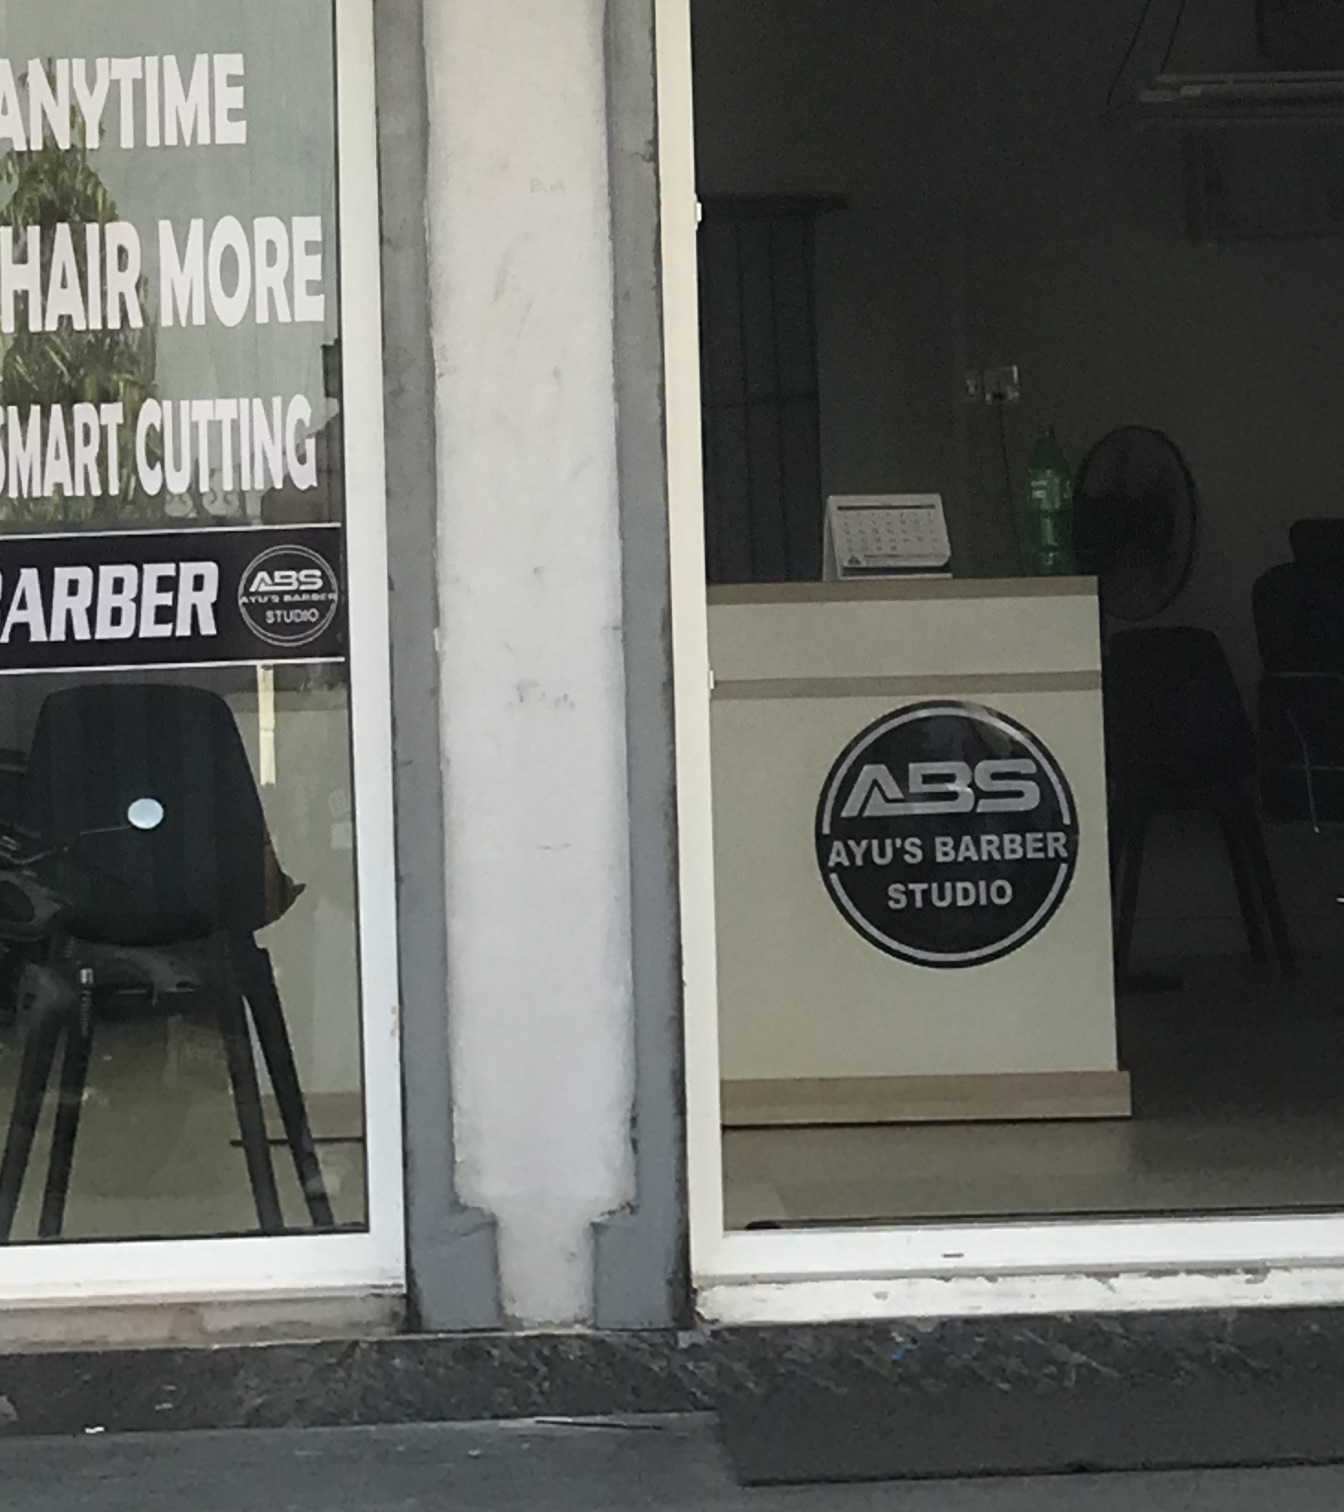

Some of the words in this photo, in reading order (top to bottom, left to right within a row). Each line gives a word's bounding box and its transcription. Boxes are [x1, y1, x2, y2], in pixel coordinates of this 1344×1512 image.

[157, 214, 326, 328] MORE
[136, 393, 318, 496] CUTTING
[249, 569, 324, 592] ABS
[265, 607, 320, 624] STUDIO
[840, 758, 1041, 818] ABS
[827, 836, 924, 868] AYU'S
[934, 830, 1069, 863] BARBER
[887, 878, 1014, 910] STUDIO
